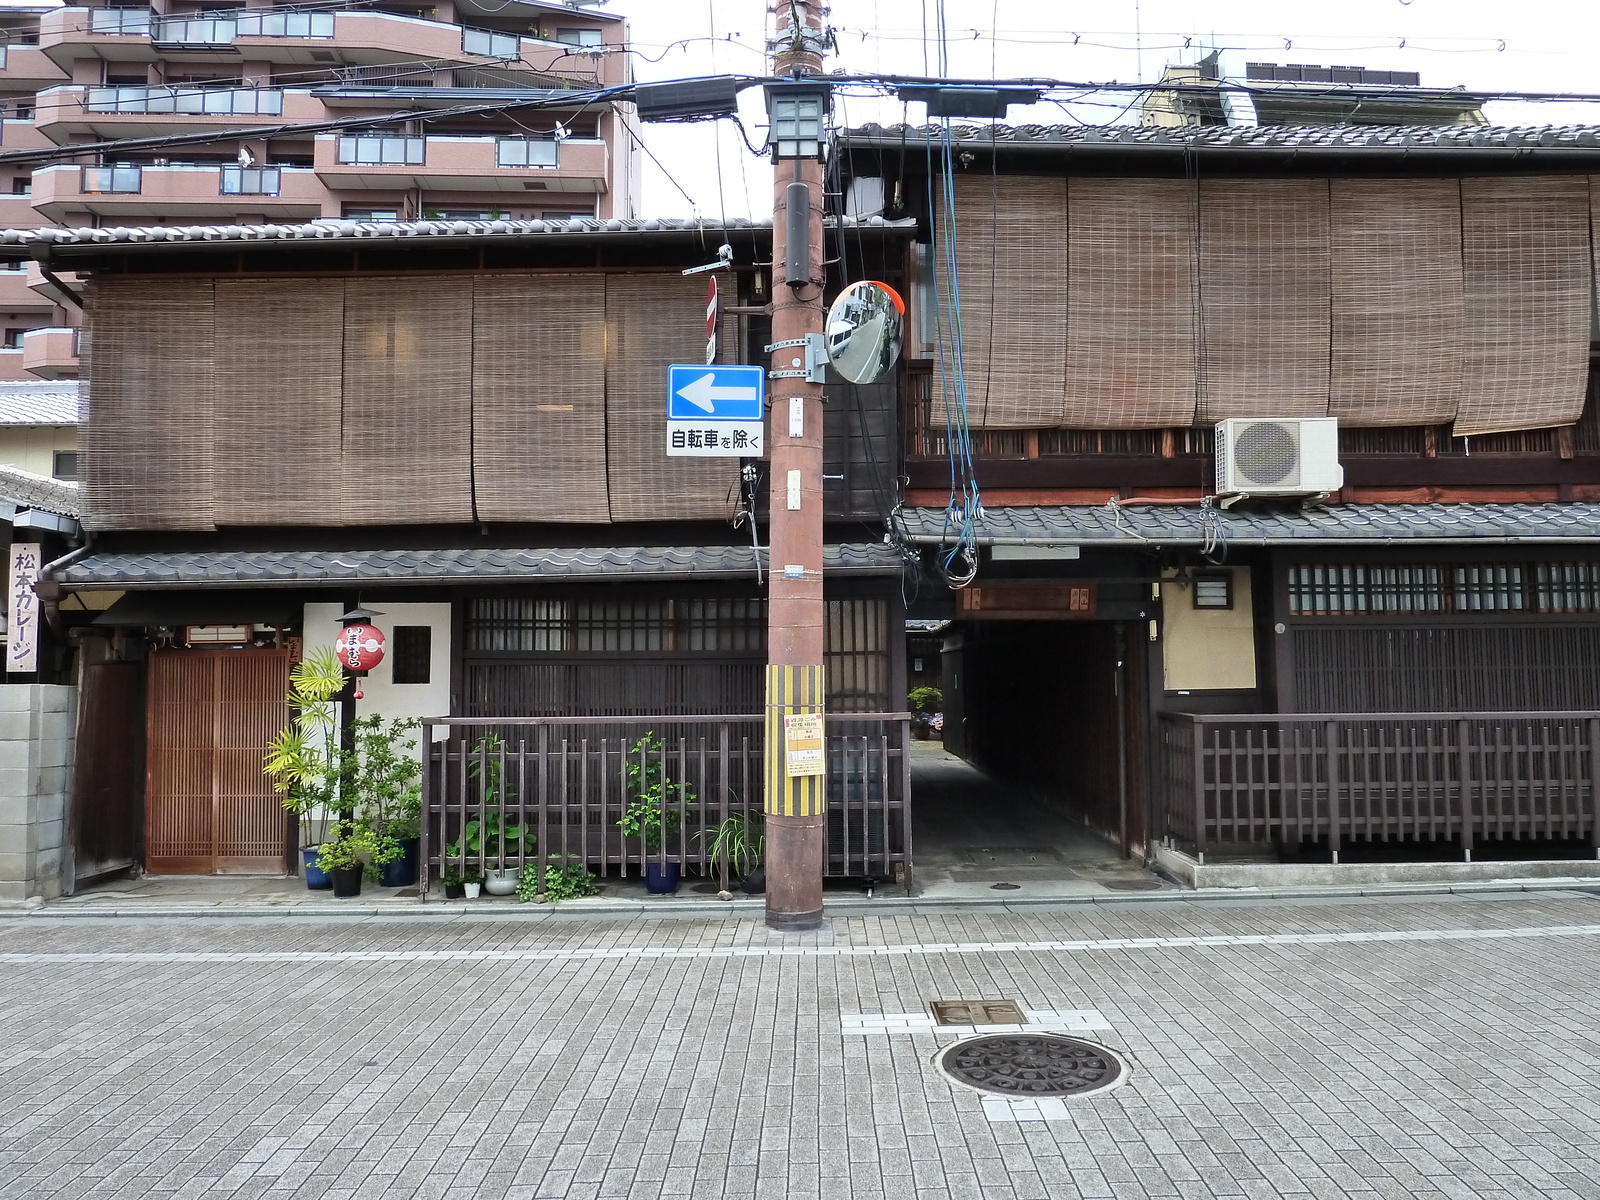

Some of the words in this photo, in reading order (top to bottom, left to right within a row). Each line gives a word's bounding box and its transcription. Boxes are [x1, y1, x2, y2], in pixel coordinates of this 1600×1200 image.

[672, 429, 759, 448] 自転車を除く
[346, 627, 363, 667] いまむら
